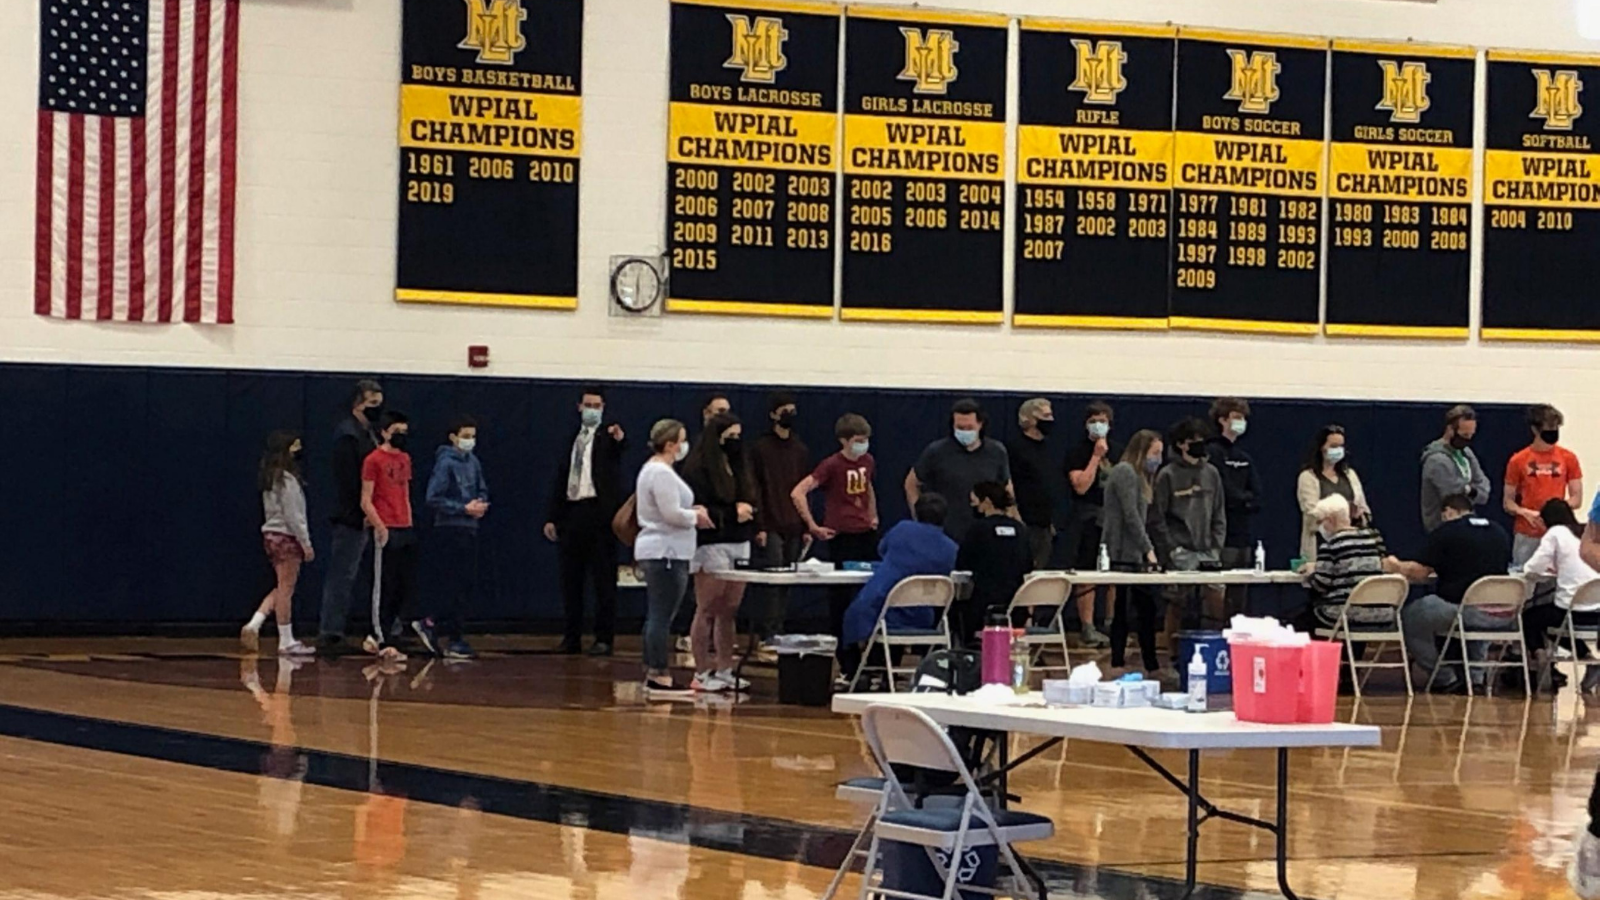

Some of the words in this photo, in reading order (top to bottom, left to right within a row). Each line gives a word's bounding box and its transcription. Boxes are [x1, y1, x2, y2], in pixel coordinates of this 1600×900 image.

[412, 65, 456, 81] BOYS
[462, 70, 574, 90] BASKETBALL
[691, 85, 731, 100] BOYS
[738, 88, 821, 106] LACROSSE
[862, 97, 907, 111] GIRLS
[913, 100, 992, 117] LACROSSE
[449, 95, 537, 120] WPIAL
[1077, 110, 1118, 124] RIFLE
[411, 120, 574, 150] CHAMPIONS
[715, 112, 797, 136] WPIAL
[887, 123, 965, 146] WPIAL
[1203, 116, 1239, 130] BOYS
[1242, 119, 1300, 138] SOCCER
[1355, 126, 1394, 140] GIRLS
[1399, 129, 1452, 142] SOCCER
[679, 137, 830, 165] CHAMPIONS
[1060, 134, 1135, 155] WPIAL
[1215, 141, 1287, 163] WPIAL
[1523, 135, 1590, 149] SOFTBALL
[409, 153, 453, 175] 1961
[470, 158, 513, 178] 2006
[530, 161, 573, 182] 2010
[853, 148, 998, 173] CHAMPIONS
[1027, 158, 1166, 182] CHAMPIONS
[1369, 151, 1438, 171] WPIAL
[1522, 158, 1590, 178] WPIAL
[676, 169, 717, 189] 2000
[733, 172, 774, 193] 2002
[788, 176, 829, 196] 2003
[1182, 164, 1316, 190] CHAMPIONS
[1334, 174, 1466, 200] CHAMPIONS
[408, 181, 453, 202] 2019
[852, 180, 892, 199] 2002
[906, 182, 945, 202] 2003
[960, 185, 1000, 204] 2004
[1026, 189, 1064, 208] 1954
[1078, 191, 1115, 210] 1958
[1129, 193, 1166, 213] 1971
[676, 195, 717, 216] 2006
[733, 199, 774, 219] 2007
[788, 202, 829, 222] 2008
[852, 205, 891, 225] 2005
[906, 208, 946, 227] 2006
[961, 210, 999, 229] 2014
[1180, 194, 1218, 213] 1977
[1231, 197, 1266, 216] 1981
[1280, 201, 1316, 219] 1982
[1336, 203, 1372, 222] 1980
[1384, 205, 1419, 224] 1983
[1432, 207, 1467, 225] 1984
[1025, 214, 1064, 233] 1987
[1077, 216, 1115, 235] 2002
[1129, 219, 1166, 237] 2003
[1492, 210, 1525, 228] 2004
[1538, 211, 1572, 229] 2010
[674, 222, 716, 242] 2009
[732, 225, 772, 246] 2011
[788, 228, 828, 248] 2013
[851, 231, 891, 251] 2016
[1179, 219, 1217, 238] 1984
[1230, 222, 1266, 241] 1989
[1279, 225, 1315, 244] 1993
[1336, 228, 1371, 246] 1993
[1384, 229, 1419, 248] 2000
[1432, 231, 1466, 249] 2008
[674, 248, 716, 269] 2015
[1024, 240, 1063, 259] 2007
[1179, 243, 1216, 263] 1997
[1229, 247, 1265, 266] 1998
[1278, 250, 1315, 268] 2002
[1178, 269, 1215, 288] 2009
